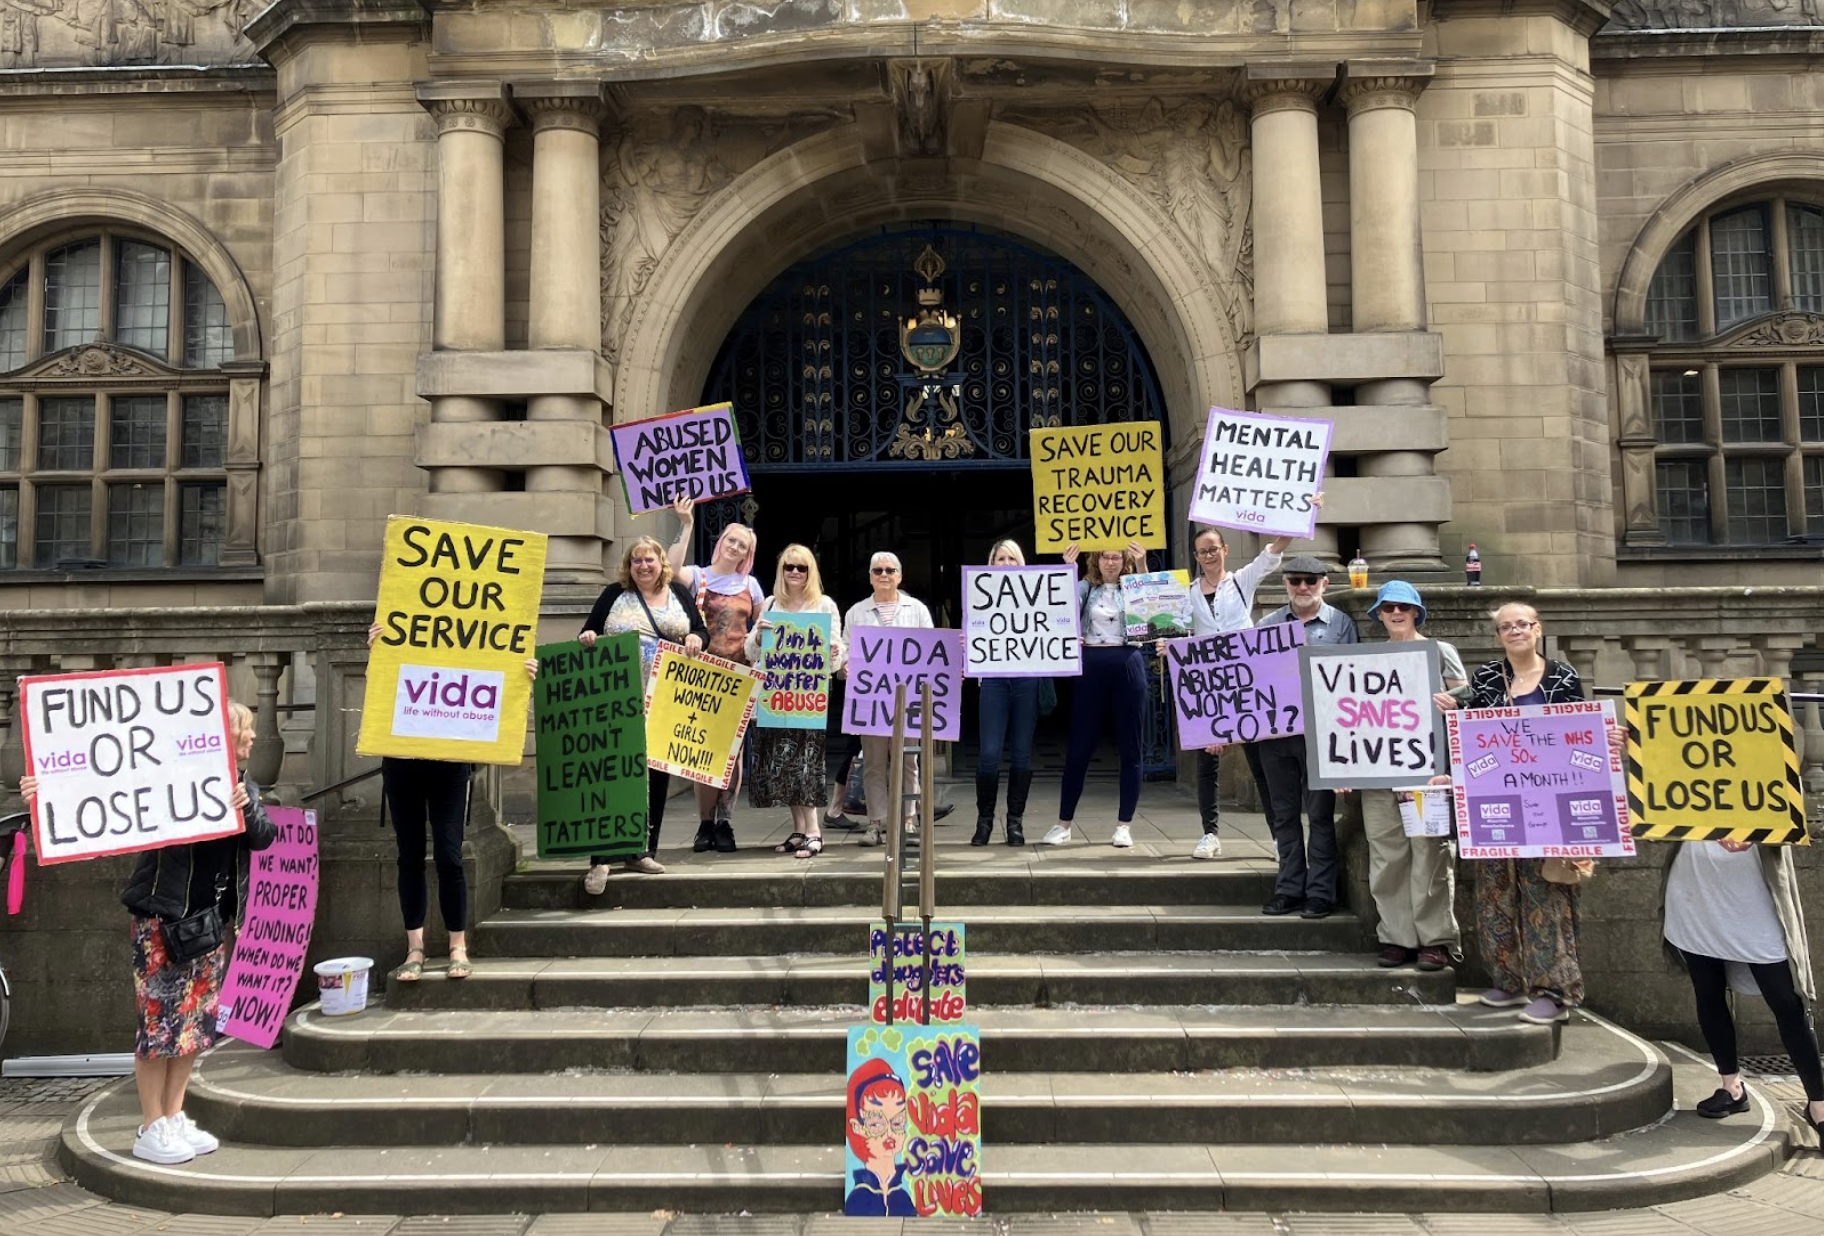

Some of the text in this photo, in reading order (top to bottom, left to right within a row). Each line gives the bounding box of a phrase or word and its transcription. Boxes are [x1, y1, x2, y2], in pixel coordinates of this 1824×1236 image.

[634, 418, 731, 460] ABUSED
[1040, 430, 1157, 462] SAVE OUR
[1216, 420, 1320, 450] MENTAL
[627, 446, 728, 484] WOMEN
[1052, 464, 1152, 490] TRAUMA
[1210, 452, 1317, 482] HEALTH
[641, 472, 738, 509] NEED US
[1040, 489, 1156, 516] RECOVERY
[1198, 483, 1312, 512] MATTERS
[1048, 514, 1154, 542] SERVICE
[1236, 510, 1264, 522] vida
[396, 526, 525, 574] SAVE
[420, 577, 506, 612] OUR
[972, 573, 1068, 611] SAVE
[380, 611, 532, 654] SERVICE
[786, 625, 805, 650] in
[807, 627, 824, 651] 4
[990, 611, 1050, 636] OUR
[860, 636, 950, 666] VIDA
[970, 637, 1079, 664] SERVICE
[1168, 624, 1304, 666] WHERE WILL
[541, 644, 630, 679] MENTAL
[698, 652, 737, 671] FRAGILE
[404, 672, 497, 709] vida
[546, 668, 630, 706] HEALTH
[665, 660, 742, 696] PRIORITISE
[853, 670, 950, 697] SAVES
[1178, 662, 1254, 695] ABUSED
[42, 676, 214, 734] FUND US
[404, 706, 494, 720] life without abuse
[674, 688, 722, 714] WOMEN
[1178, 685, 1276, 720] WOMEN
[1336, 697, 1420, 731] SAVES
[1465, 702, 1602, 720] FRAGILE FRAGILE
[736, 697, 756, 738] FRAGILE
[1501, 719, 1531, 734] WE
[176, 734, 220, 750] vida
[562, 722, 622, 756] DON'T
[674, 723, 707, 745] GIRLS
[1448, 713, 1462, 765] FRAGILE
[1476, 730, 1593, 748] SAVE THE NHS
[38, 750, 86, 768] vida
[90, 726, 162, 776] OR
[668, 742, 714, 772] NOW!!!
[1470, 758, 1496, 772] vida
[1574, 753, 1600, 768] vida
[1682, 739, 1736, 769] OR
[546, 752, 645, 792] LEAVE US
[680, 768, 714, 784] FRAGILE
[1504, 772, 1518, 788] A
[46, 776, 227, 845] LOSE US
[581, 790, 606, 812] IN
[1482, 804, 1509, 814] vida
[1570, 801, 1600, 810] vida
[1648, 780, 1788, 812] LOSE US
[1454, 786, 1470, 838] FRAGILE
[1616, 795, 1634, 851] FRAGILE
[298, 825, 314, 845] DO
[544, 811, 648, 845] TATTERS!
[1462, 846, 1602, 856] FRAGILE FRAGILE
[259, 853, 318, 880] WE WANT?
[254, 881, 308, 910] PROPER
[246, 916, 310, 950] FUNDING!
[236, 946, 302, 972] WHEN DO WE
[237, 972, 292, 999] WANT IT?
[229, 995, 282, 1033] NOW!
